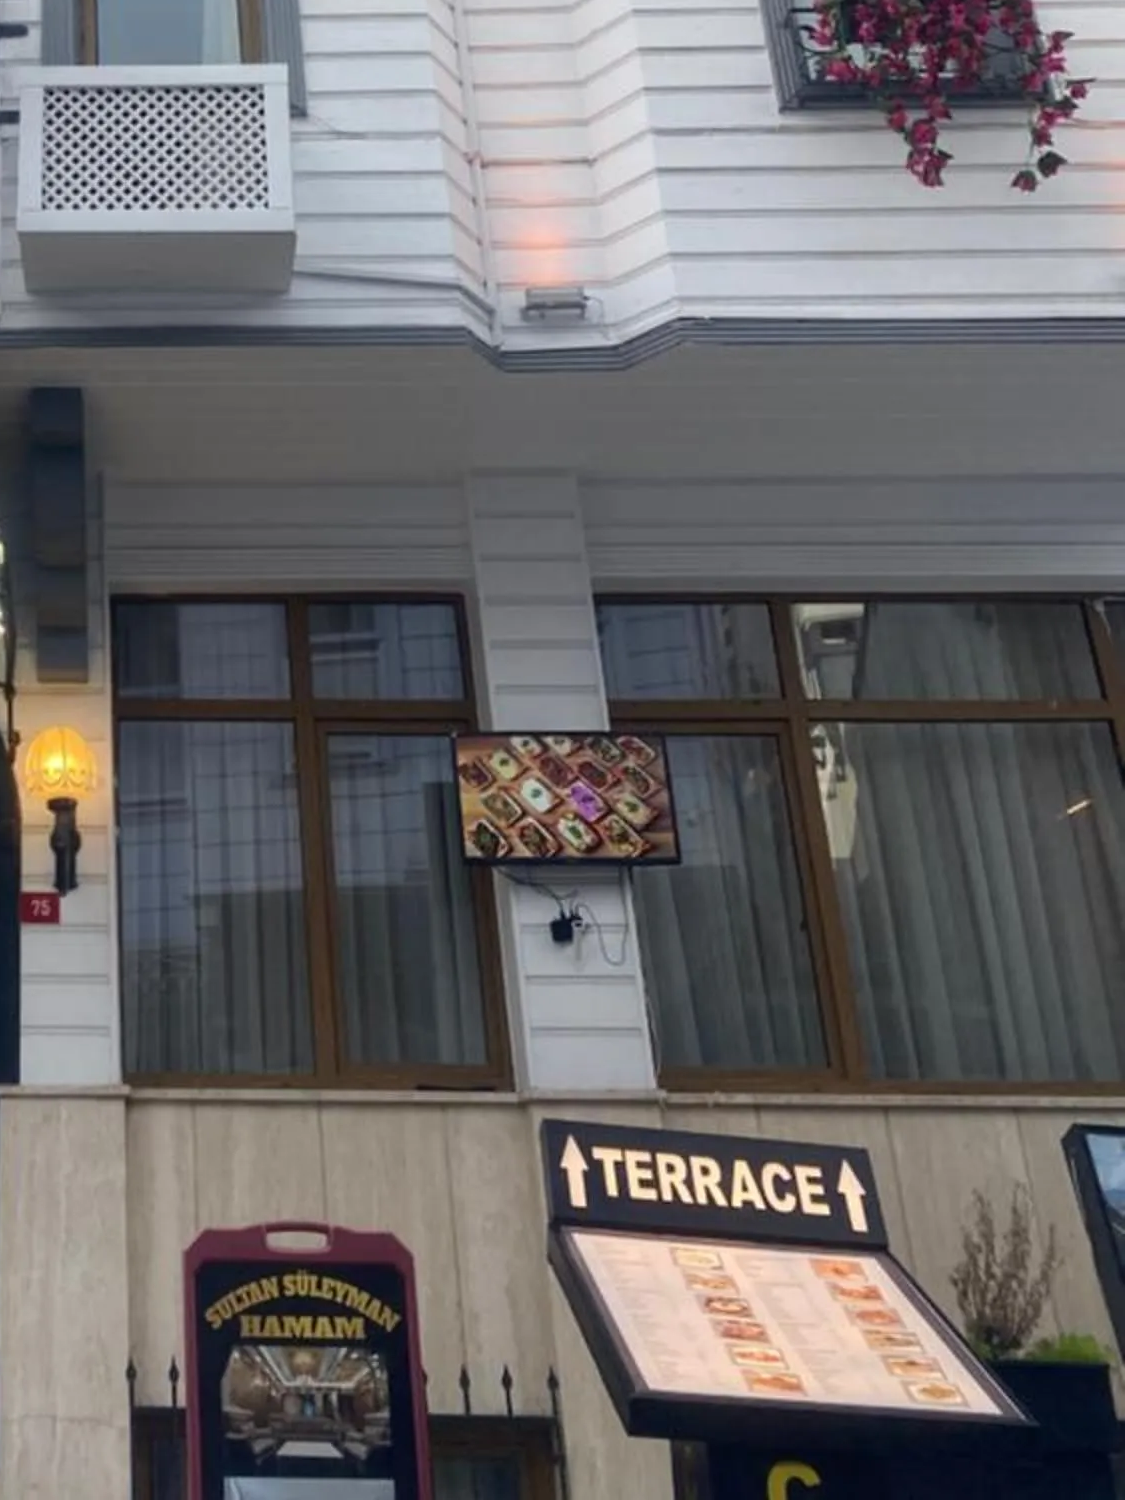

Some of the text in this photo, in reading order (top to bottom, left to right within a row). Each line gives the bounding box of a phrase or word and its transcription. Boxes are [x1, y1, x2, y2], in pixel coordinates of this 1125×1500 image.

[591, 1146, 831, 1217] TERRACE
[205, 1269, 401, 1333] SULTAN SÜLEYMAN
[240, 1314, 366, 1339] HAMAM
